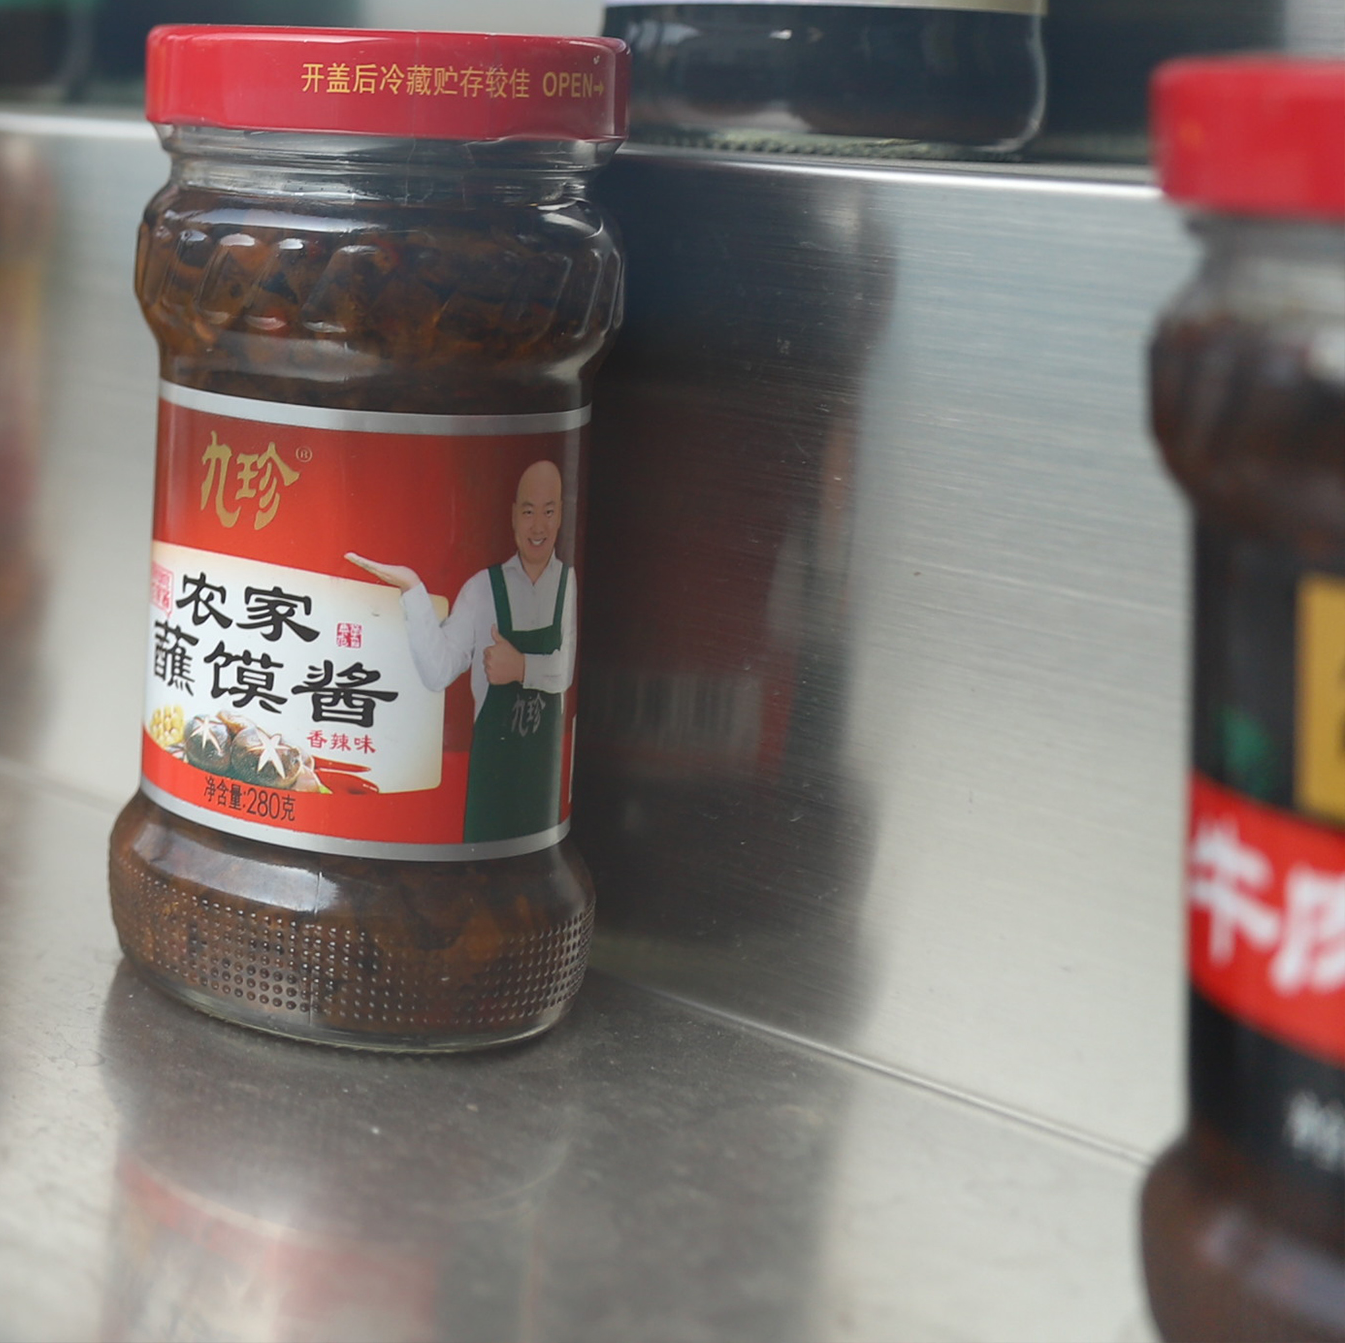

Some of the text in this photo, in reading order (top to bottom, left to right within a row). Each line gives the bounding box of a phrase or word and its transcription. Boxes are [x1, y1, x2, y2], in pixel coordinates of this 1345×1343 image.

[301, 62, 592, 99] 开盖后冷藏贮存较佳 OPEN
[199, 431, 300, 530] 九珍
[176, 571, 320, 643] 农家
[154, 620, 399, 729] 蘸馍酱
[306, 729, 377, 755] 香辣味
[204, 775, 296, 821] 净含量:280克
